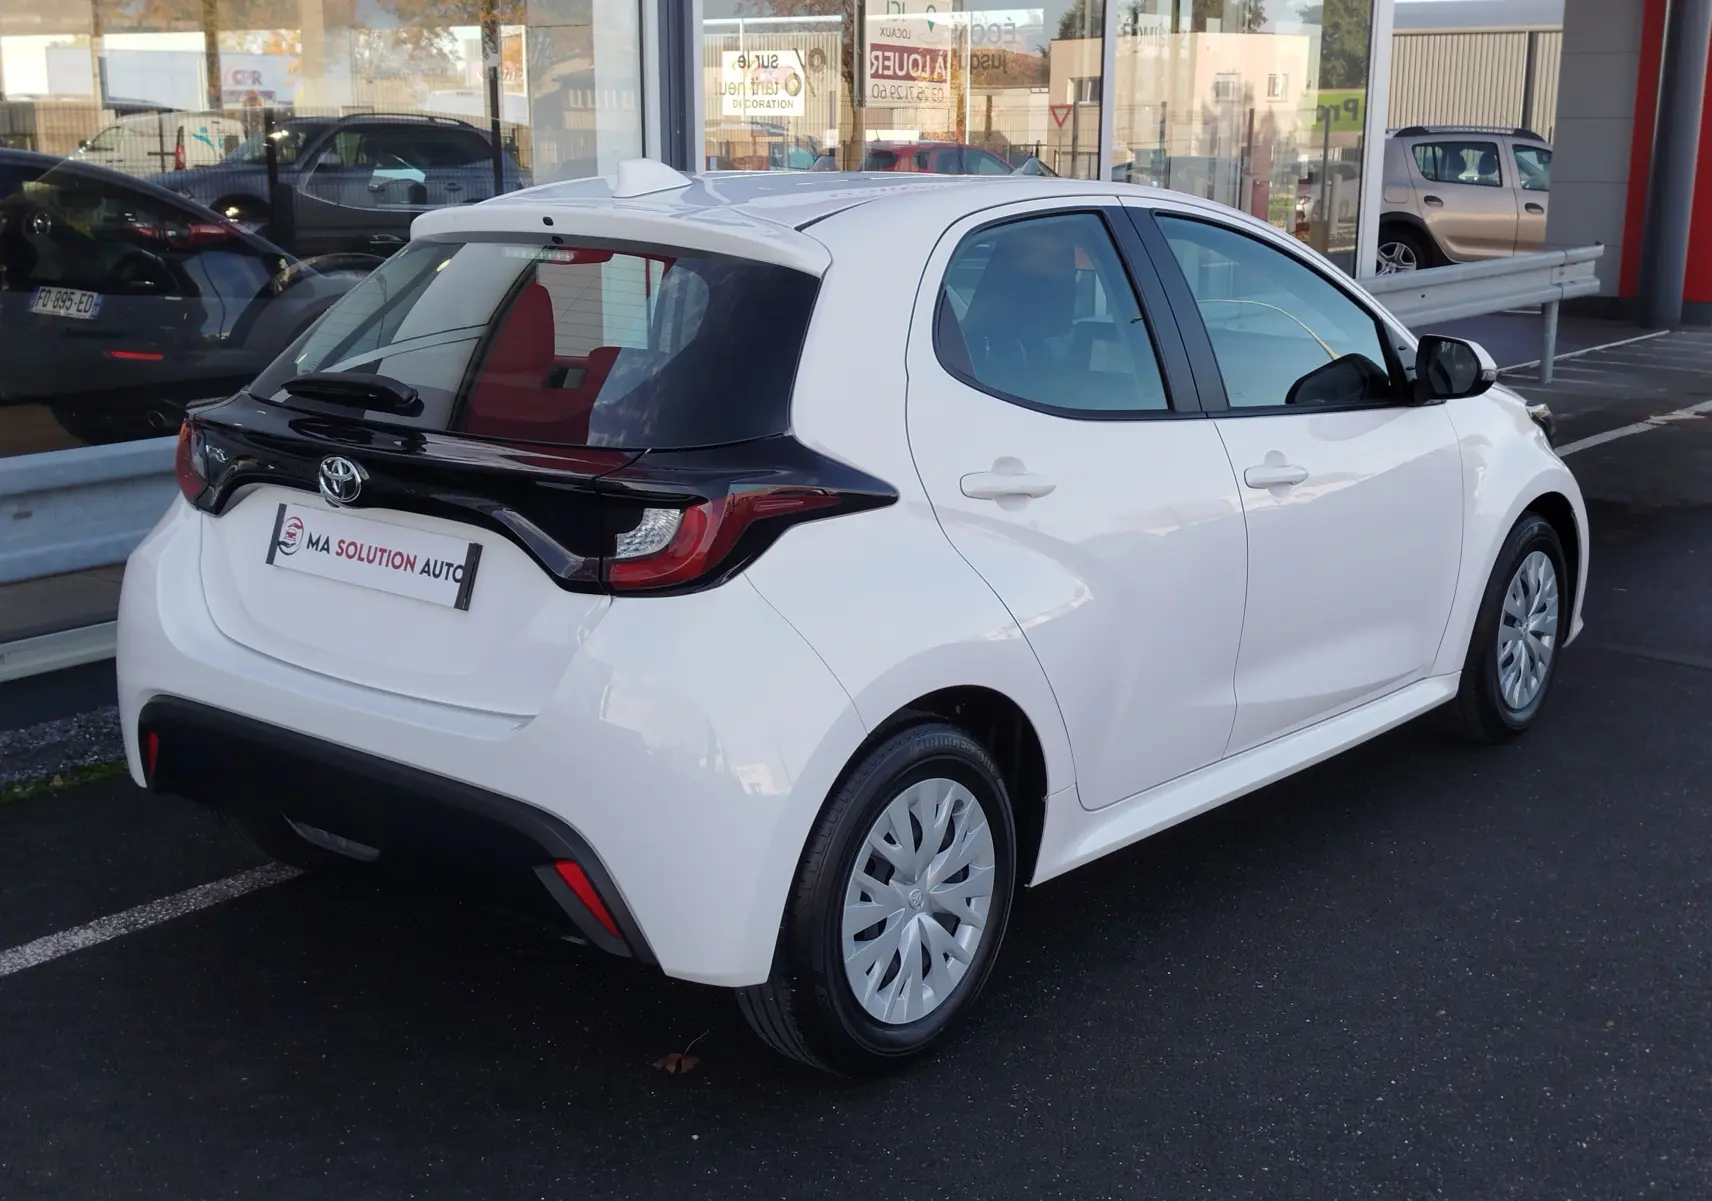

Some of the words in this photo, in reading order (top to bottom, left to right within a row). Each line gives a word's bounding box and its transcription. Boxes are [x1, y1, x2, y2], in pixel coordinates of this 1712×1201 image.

[306, 532, 330, 554] MA
[335, 538, 417, 573] SOLUTION
[419, 557, 464, 584] AUTO
